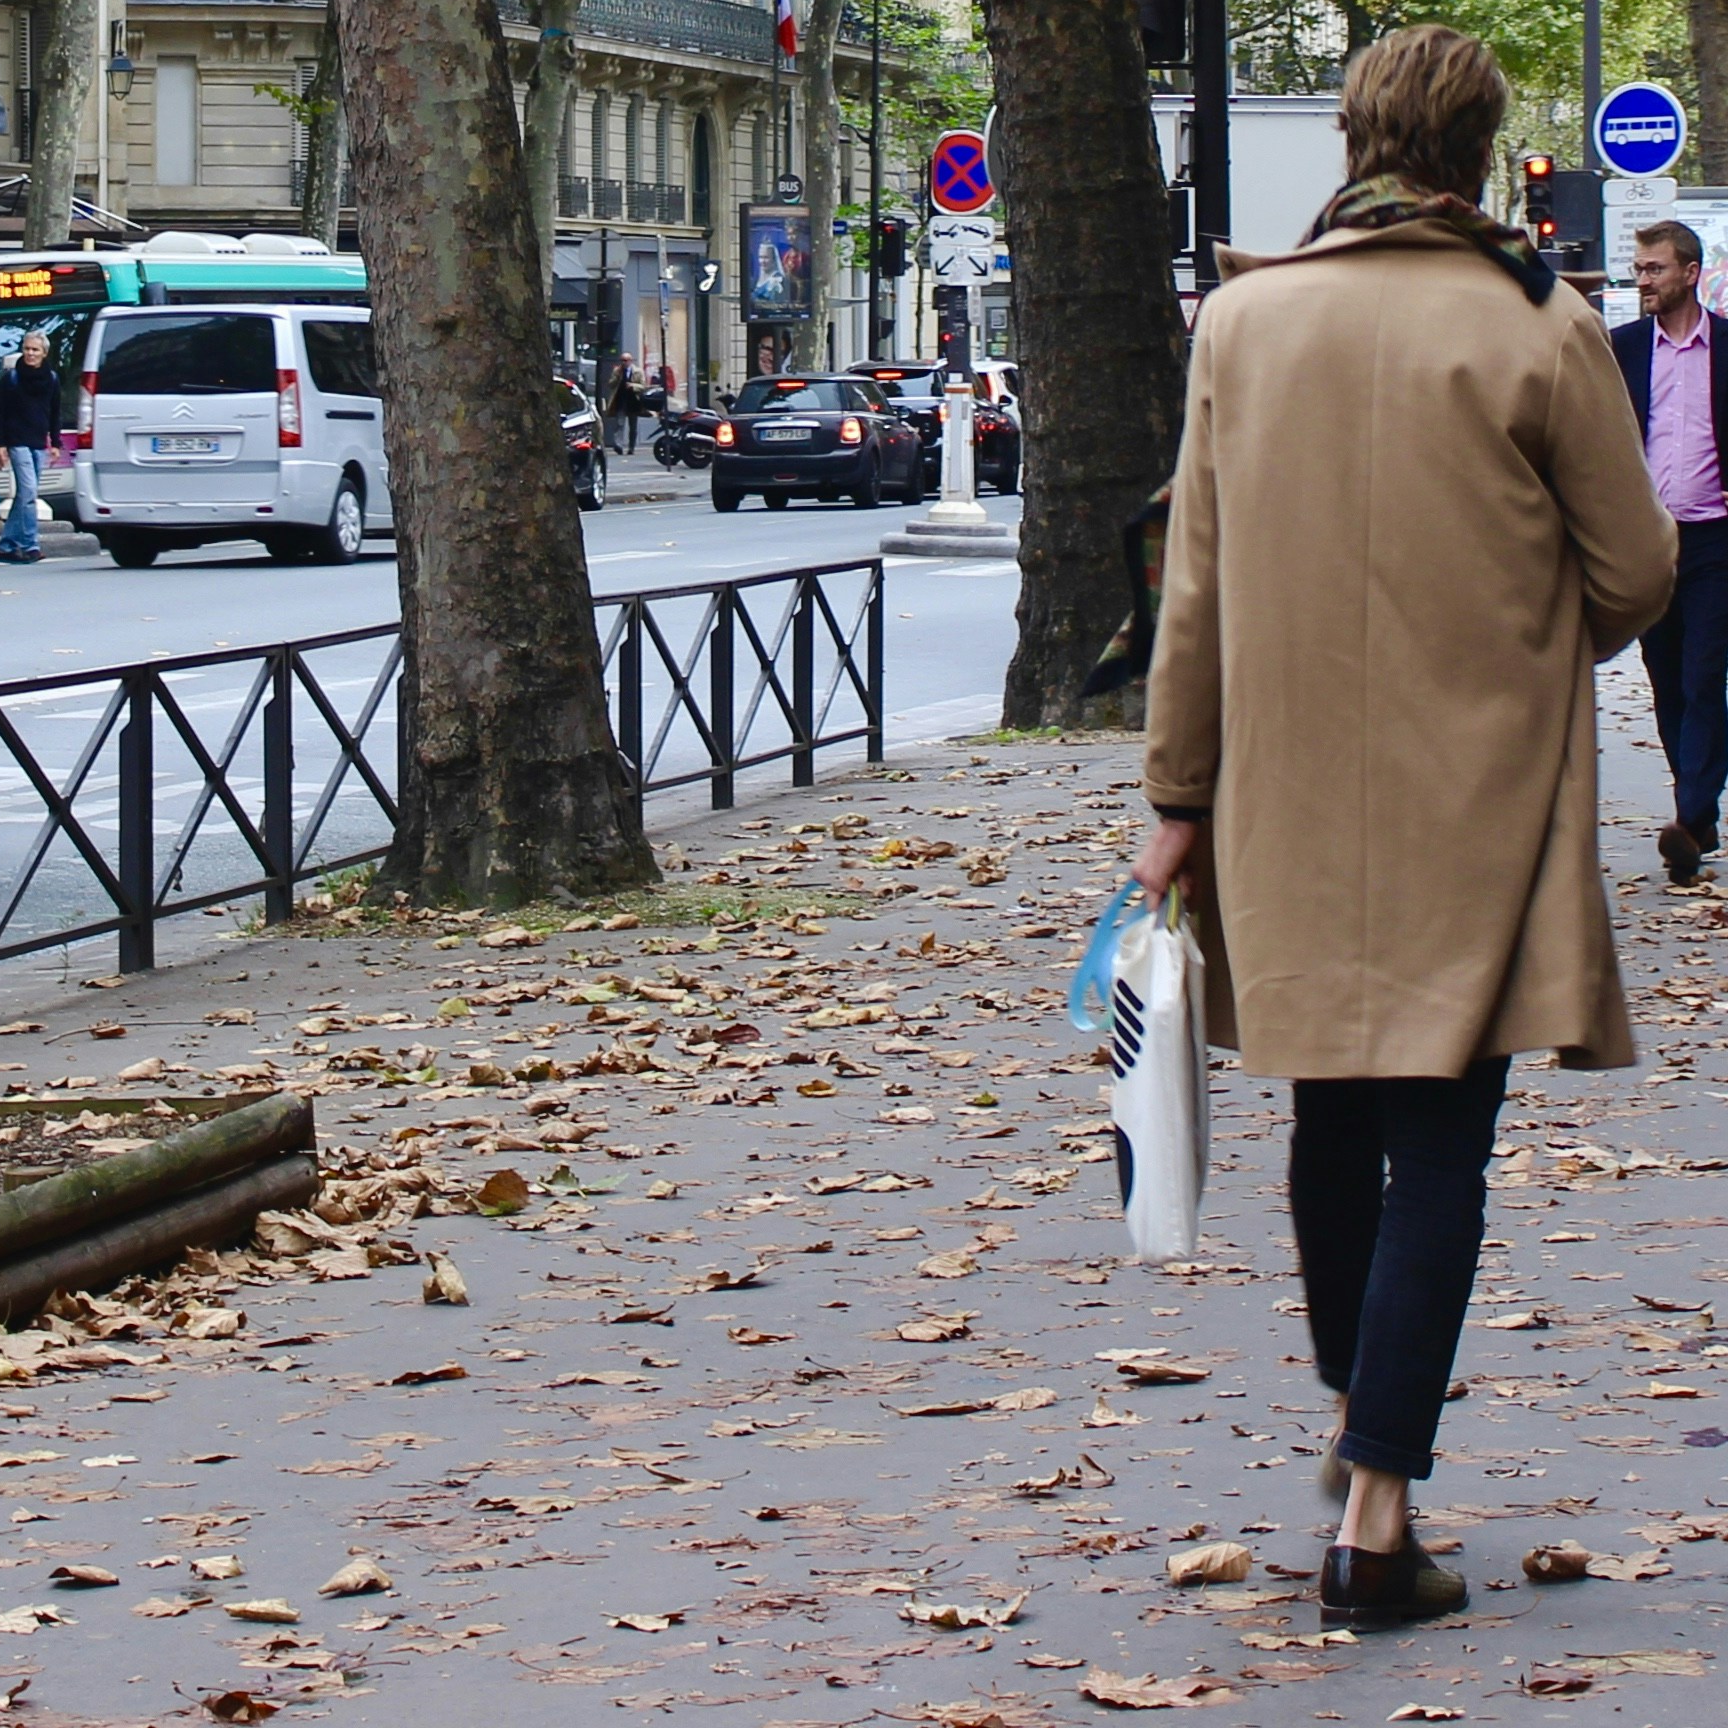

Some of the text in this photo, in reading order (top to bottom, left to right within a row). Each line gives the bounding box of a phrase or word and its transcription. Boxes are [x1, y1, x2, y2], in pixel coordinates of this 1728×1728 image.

[778, 181, 799, 192] BUS
[13, 270, 51, 283] monte
[0, 282, 52, 298] le valide
